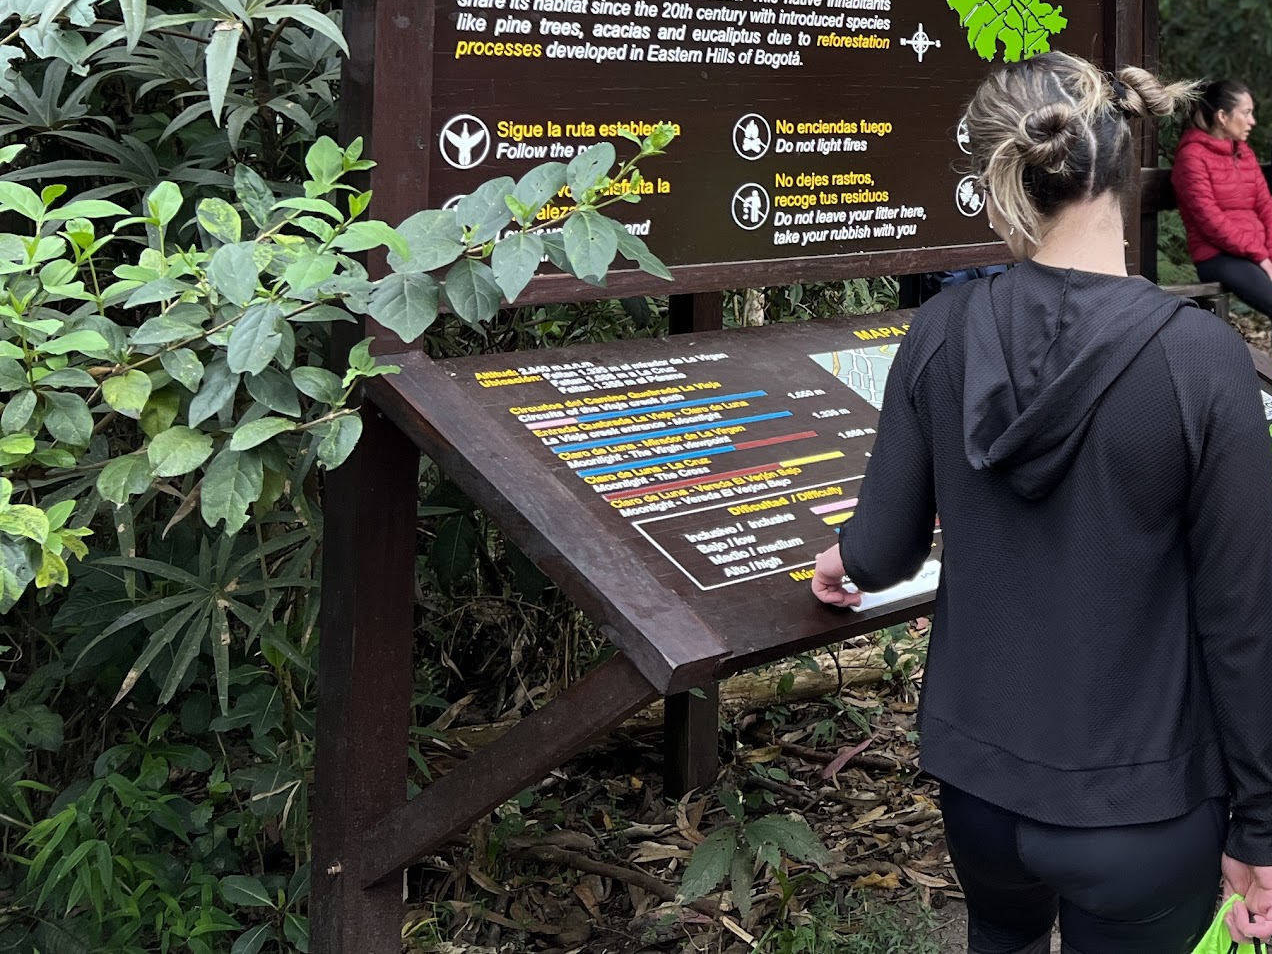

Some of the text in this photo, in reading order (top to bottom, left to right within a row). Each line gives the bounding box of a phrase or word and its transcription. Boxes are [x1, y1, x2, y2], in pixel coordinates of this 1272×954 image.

[454, 40, 543, 60] processes
[545, 40, 628, 64] developed
[629, 43, 644, 61] in
[705, 46, 736, 64] Hills
[737, 48, 754, 65] of
[754, 48, 804, 69] Bogotá.
[496, 120, 544, 142] Sigue
[547, 120, 562, 138] la
[566, 122, 596, 137] ruta
[775, 119, 893, 137] No enciendas fuego
[496, 142, 548, 159] Follow
[550, 142, 574, 158] the
[775, 137, 868, 156] Do not light fires
[657, 178, 671, 193] la
[775, 171, 875, 191] No dejes rastros,
[774, 188, 890, 210] recoge tus residuos
[773, 204, 927, 227] Do not leave your litter here,
[773, 222, 917, 247] take your rubbish with you
[853, 326, 906, 341] MAPA
